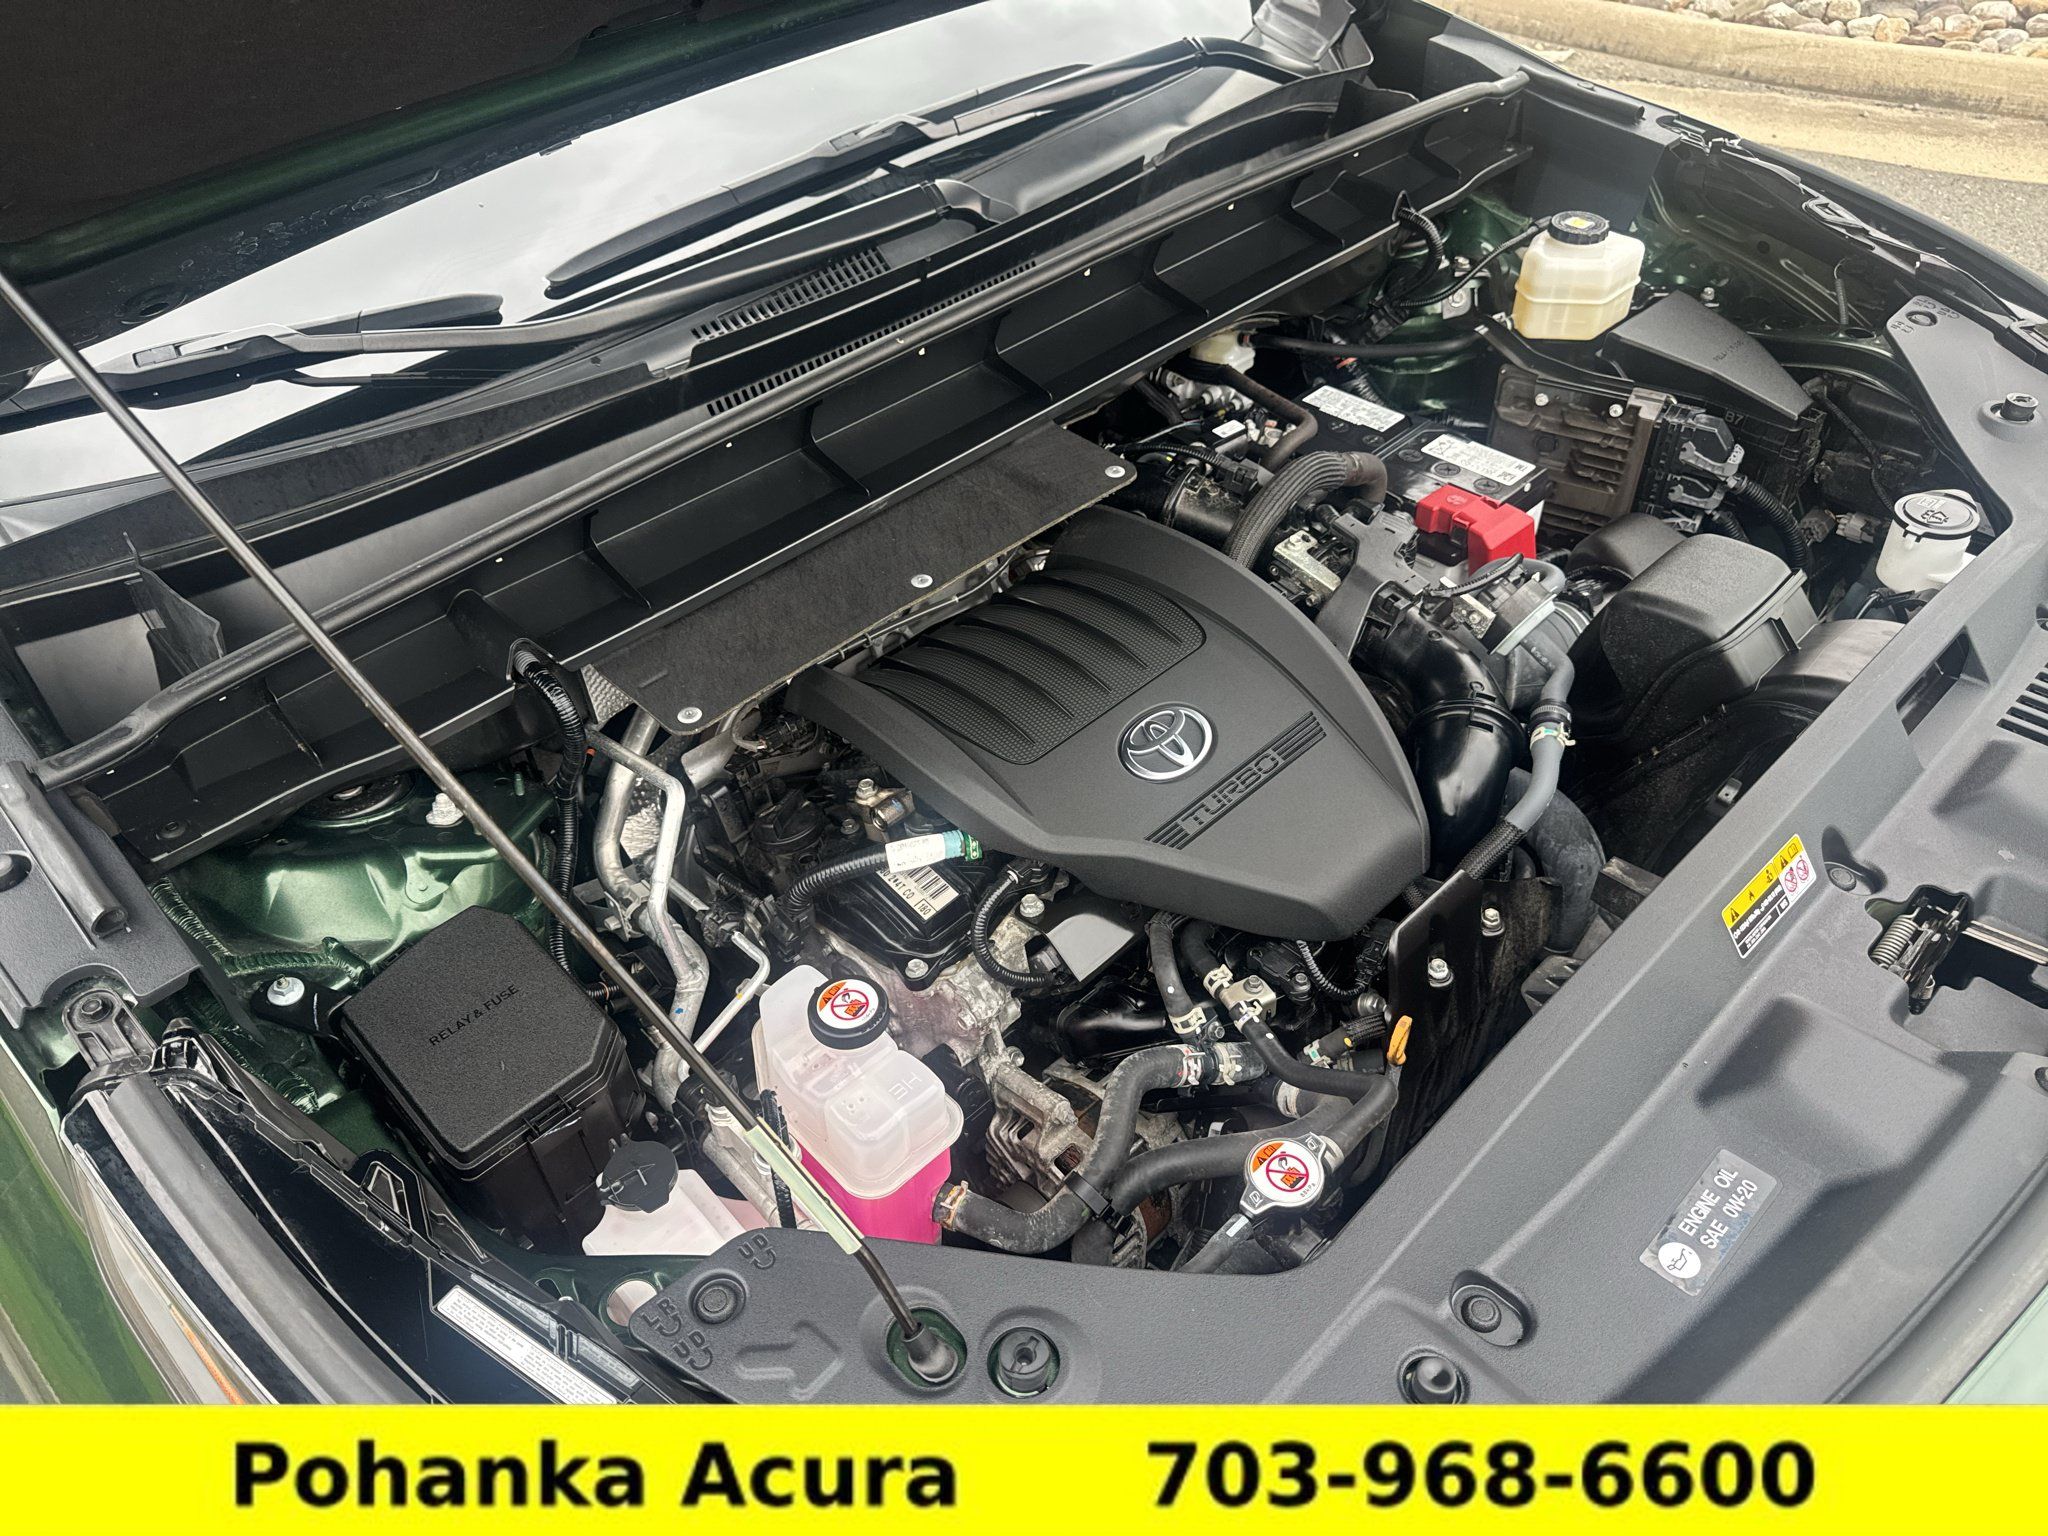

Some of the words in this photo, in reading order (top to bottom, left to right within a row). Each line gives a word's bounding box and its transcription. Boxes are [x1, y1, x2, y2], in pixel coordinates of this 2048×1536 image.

[1181, 753, 1280, 826] TURBO
[428, 1014, 471, 1047] RELAY
[473, 1008, 484, 1019] &
[483, 984, 520, 1011] FUSE
[1677, 1188, 1721, 1237] ENGINE
[1713, 1168, 1739, 1189] OIL
[1700, 1219, 1729, 1250] SAE
[1722, 1179, 1758, 1219] 0W-20
